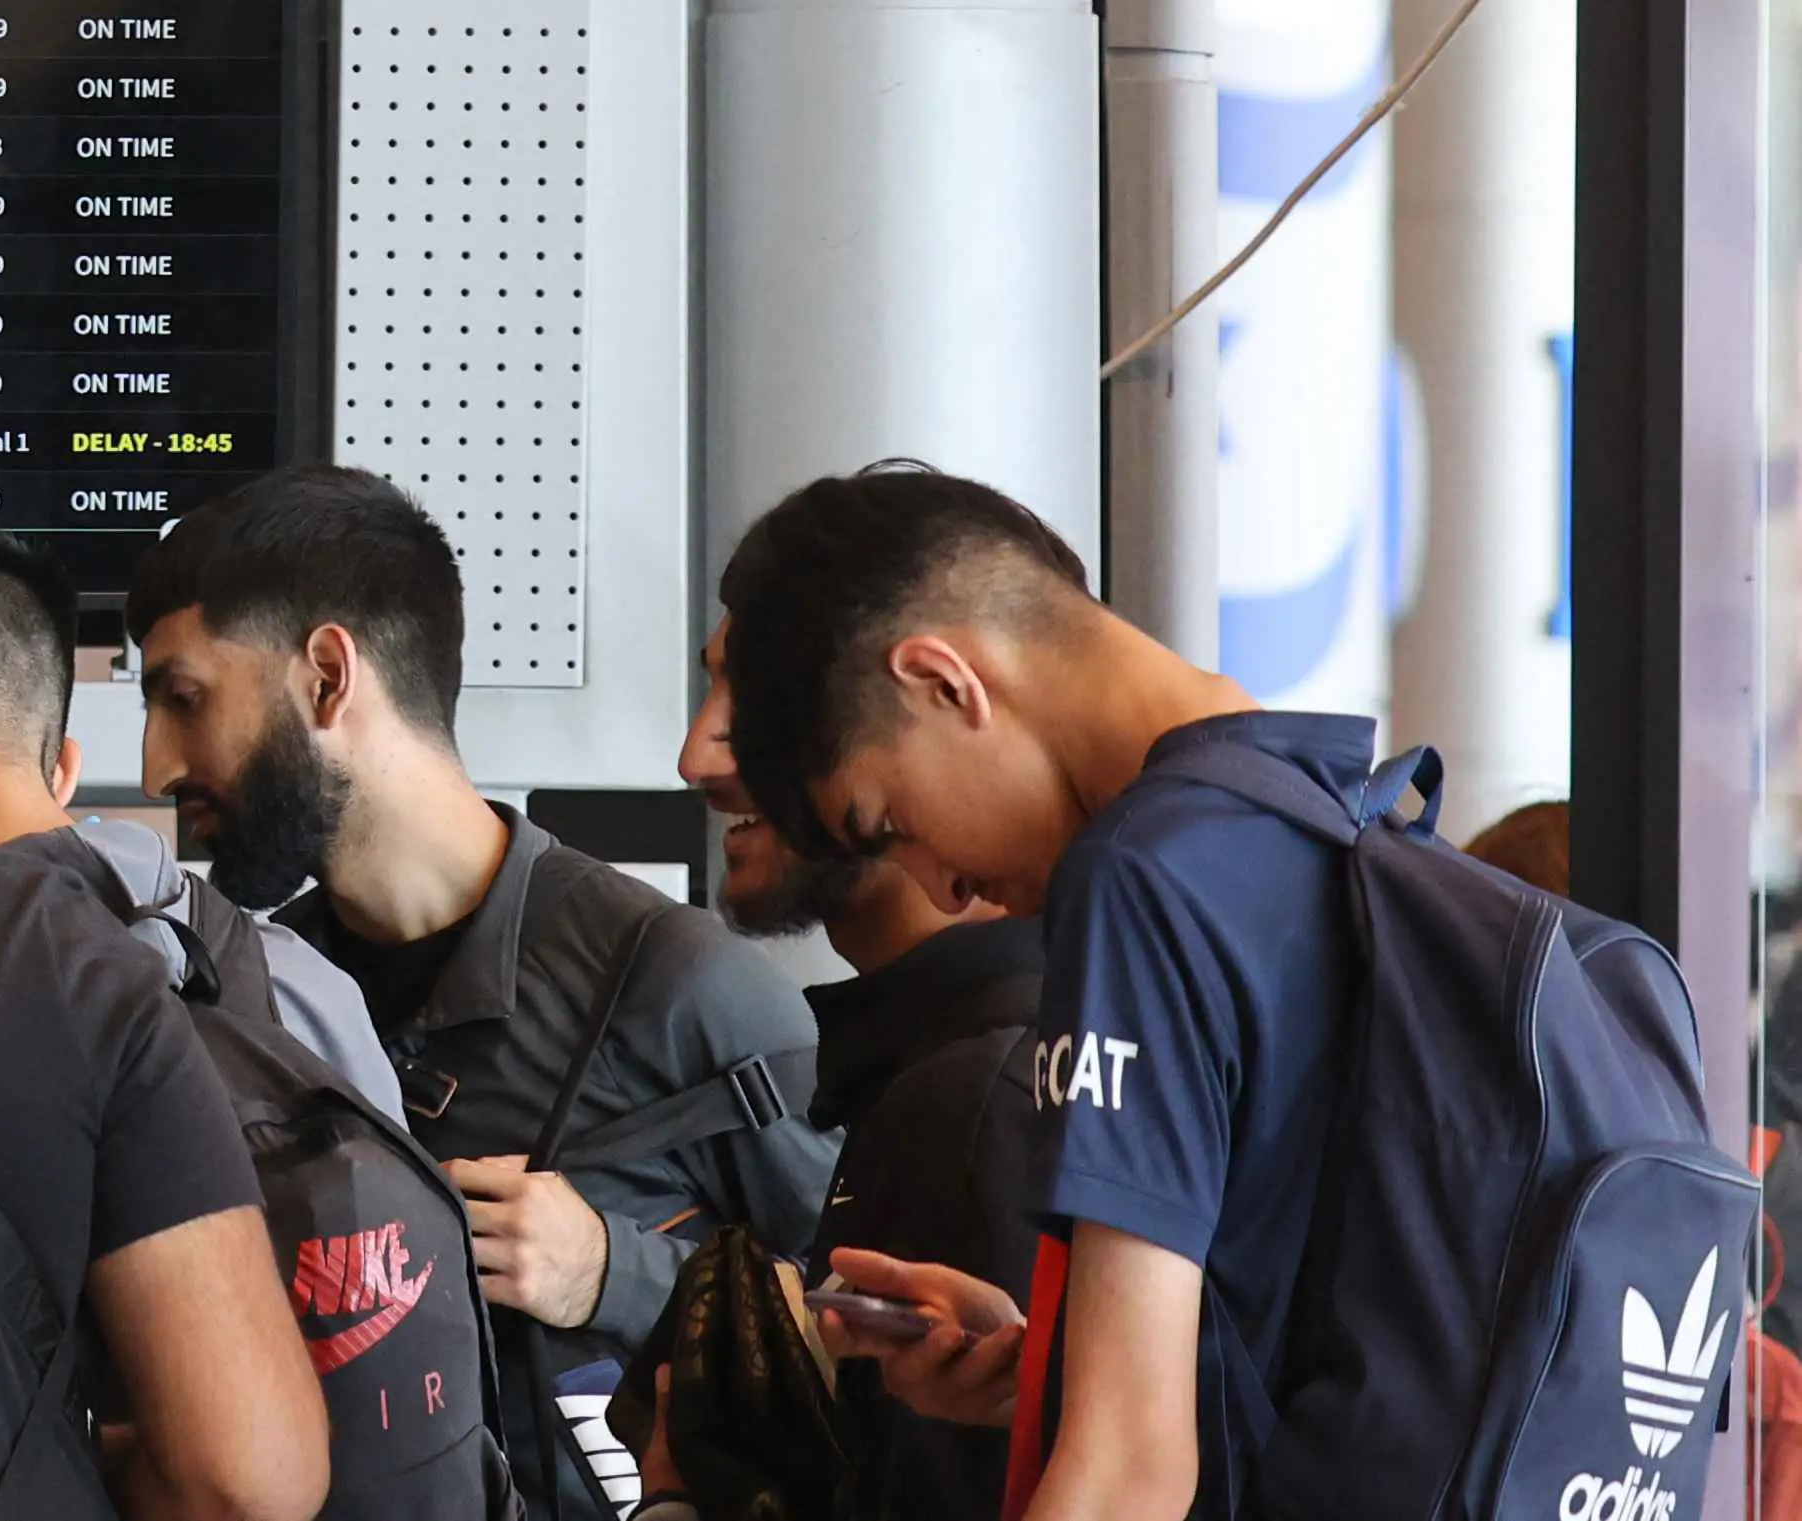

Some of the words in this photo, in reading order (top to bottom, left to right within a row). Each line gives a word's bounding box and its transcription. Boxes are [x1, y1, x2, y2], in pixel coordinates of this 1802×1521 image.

[76, 137, 112, 158] ON
[117, 137, 175, 158] TIME
[71, 490, 106, 512] ON
[111, 490, 169, 511] TIME
[293, 1219, 414, 1318] NIKE
[379, 1370, 445, 1430] IR
[1559, 1465, 1676, 1521] adidas
